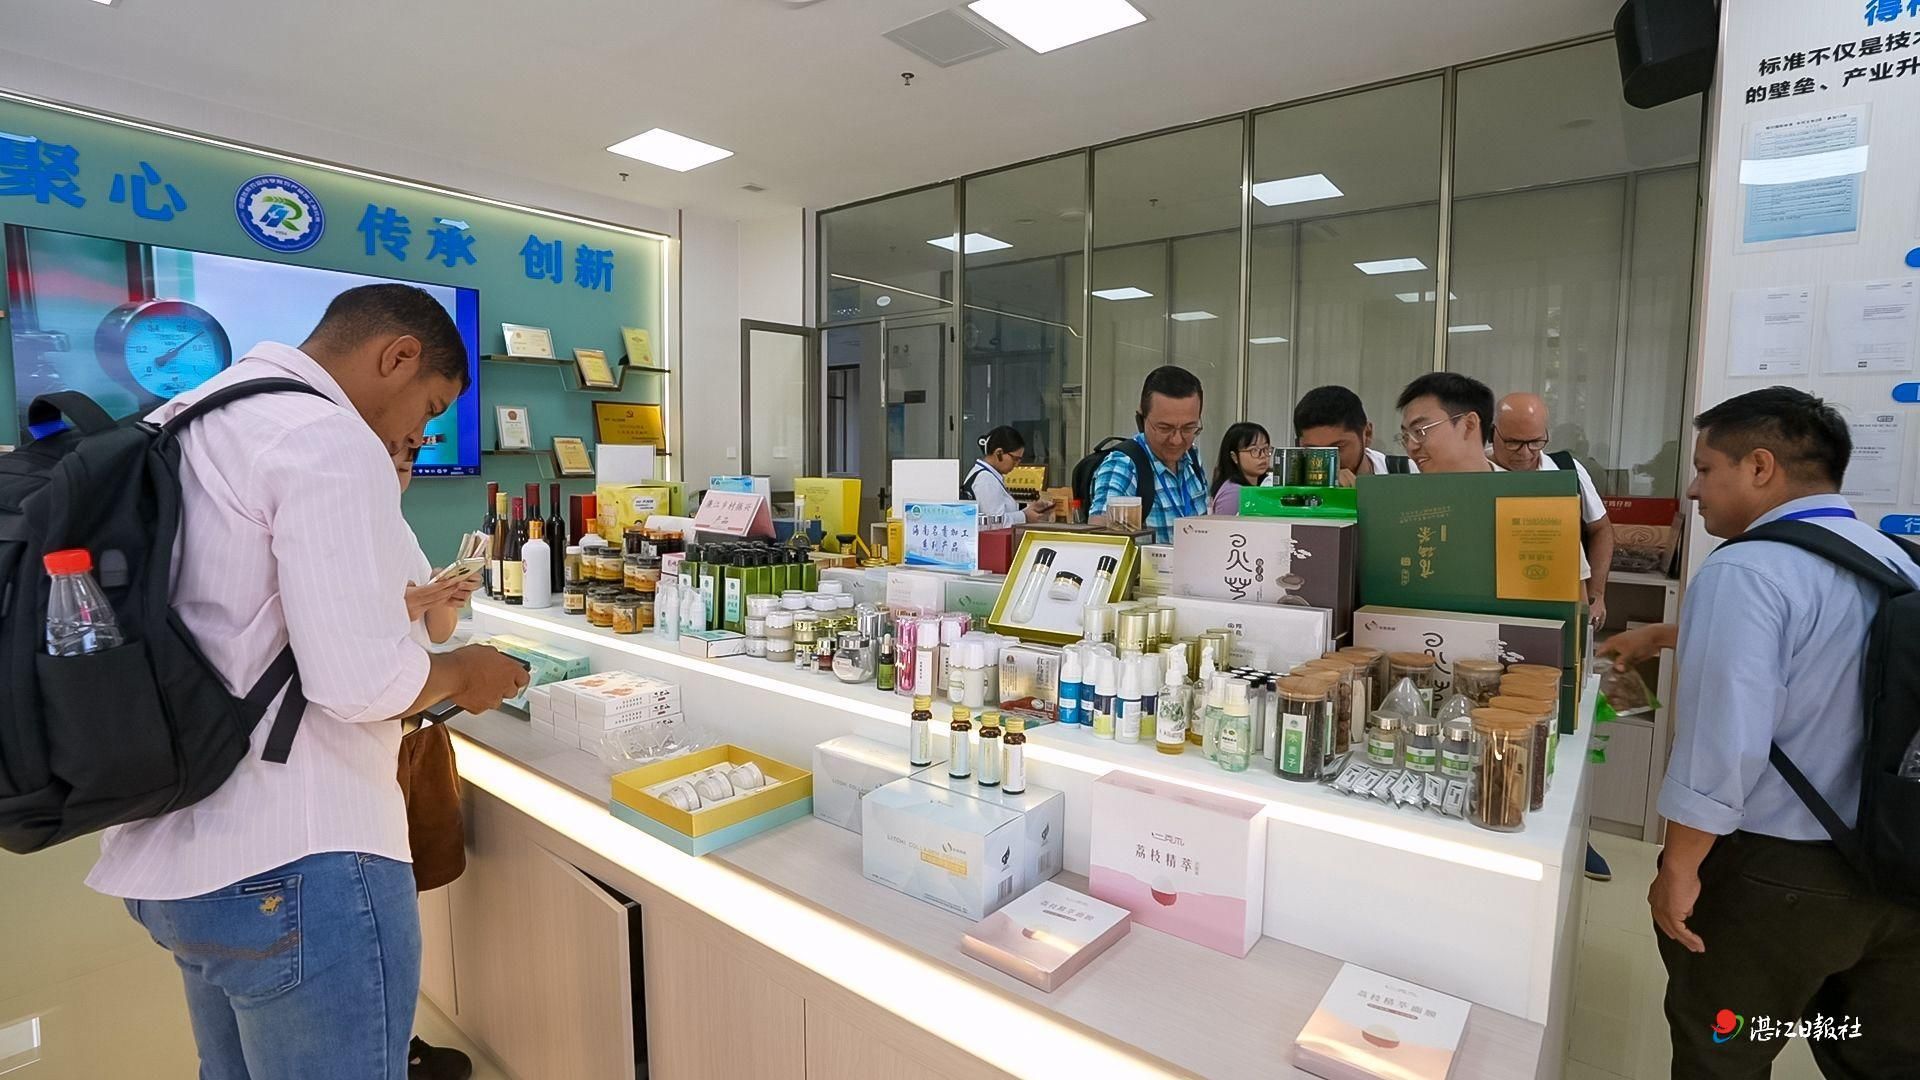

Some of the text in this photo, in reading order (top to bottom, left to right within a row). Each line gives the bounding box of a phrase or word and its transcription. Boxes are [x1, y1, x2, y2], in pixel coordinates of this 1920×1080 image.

[1745, 56, 1920, 105] 的壁垒、产业升
[0, 138, 615, 292] 聚心 传承 创新
[1136, 843, 1192, 873] 荔枝精萃
